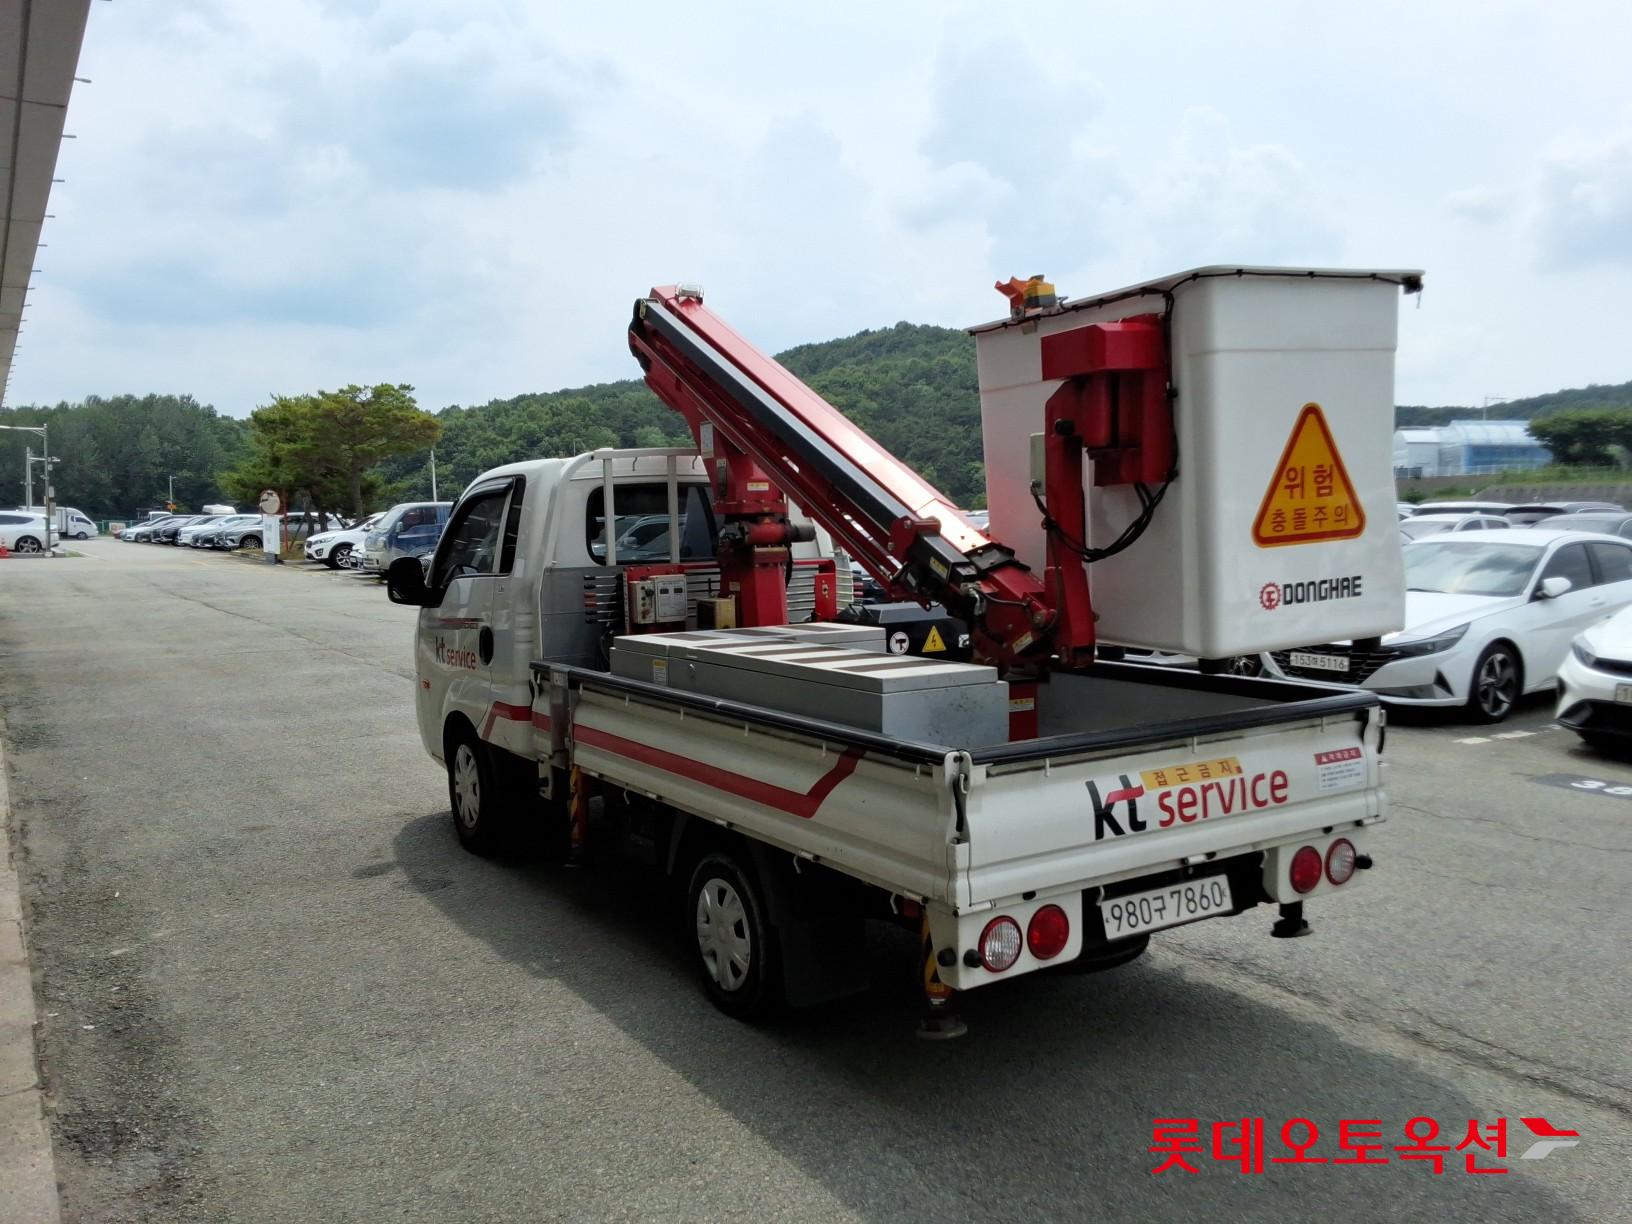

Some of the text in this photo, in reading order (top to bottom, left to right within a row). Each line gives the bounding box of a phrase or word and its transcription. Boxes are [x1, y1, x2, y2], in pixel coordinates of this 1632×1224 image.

[1284, 463, 1334, 500] 위험
[1271, 504, 1349, 533] 충돌주의
[1282, 575, 1363, 606] DONGHAE
[435, 635, 477, 671] kt service
[1152, 760, 1233, 787] 접근금지
[1085, 774, 1146, 841] kt
[1157, 769, 1289, 828] service
[1110, 881, 1223, 933] 980구 7860
